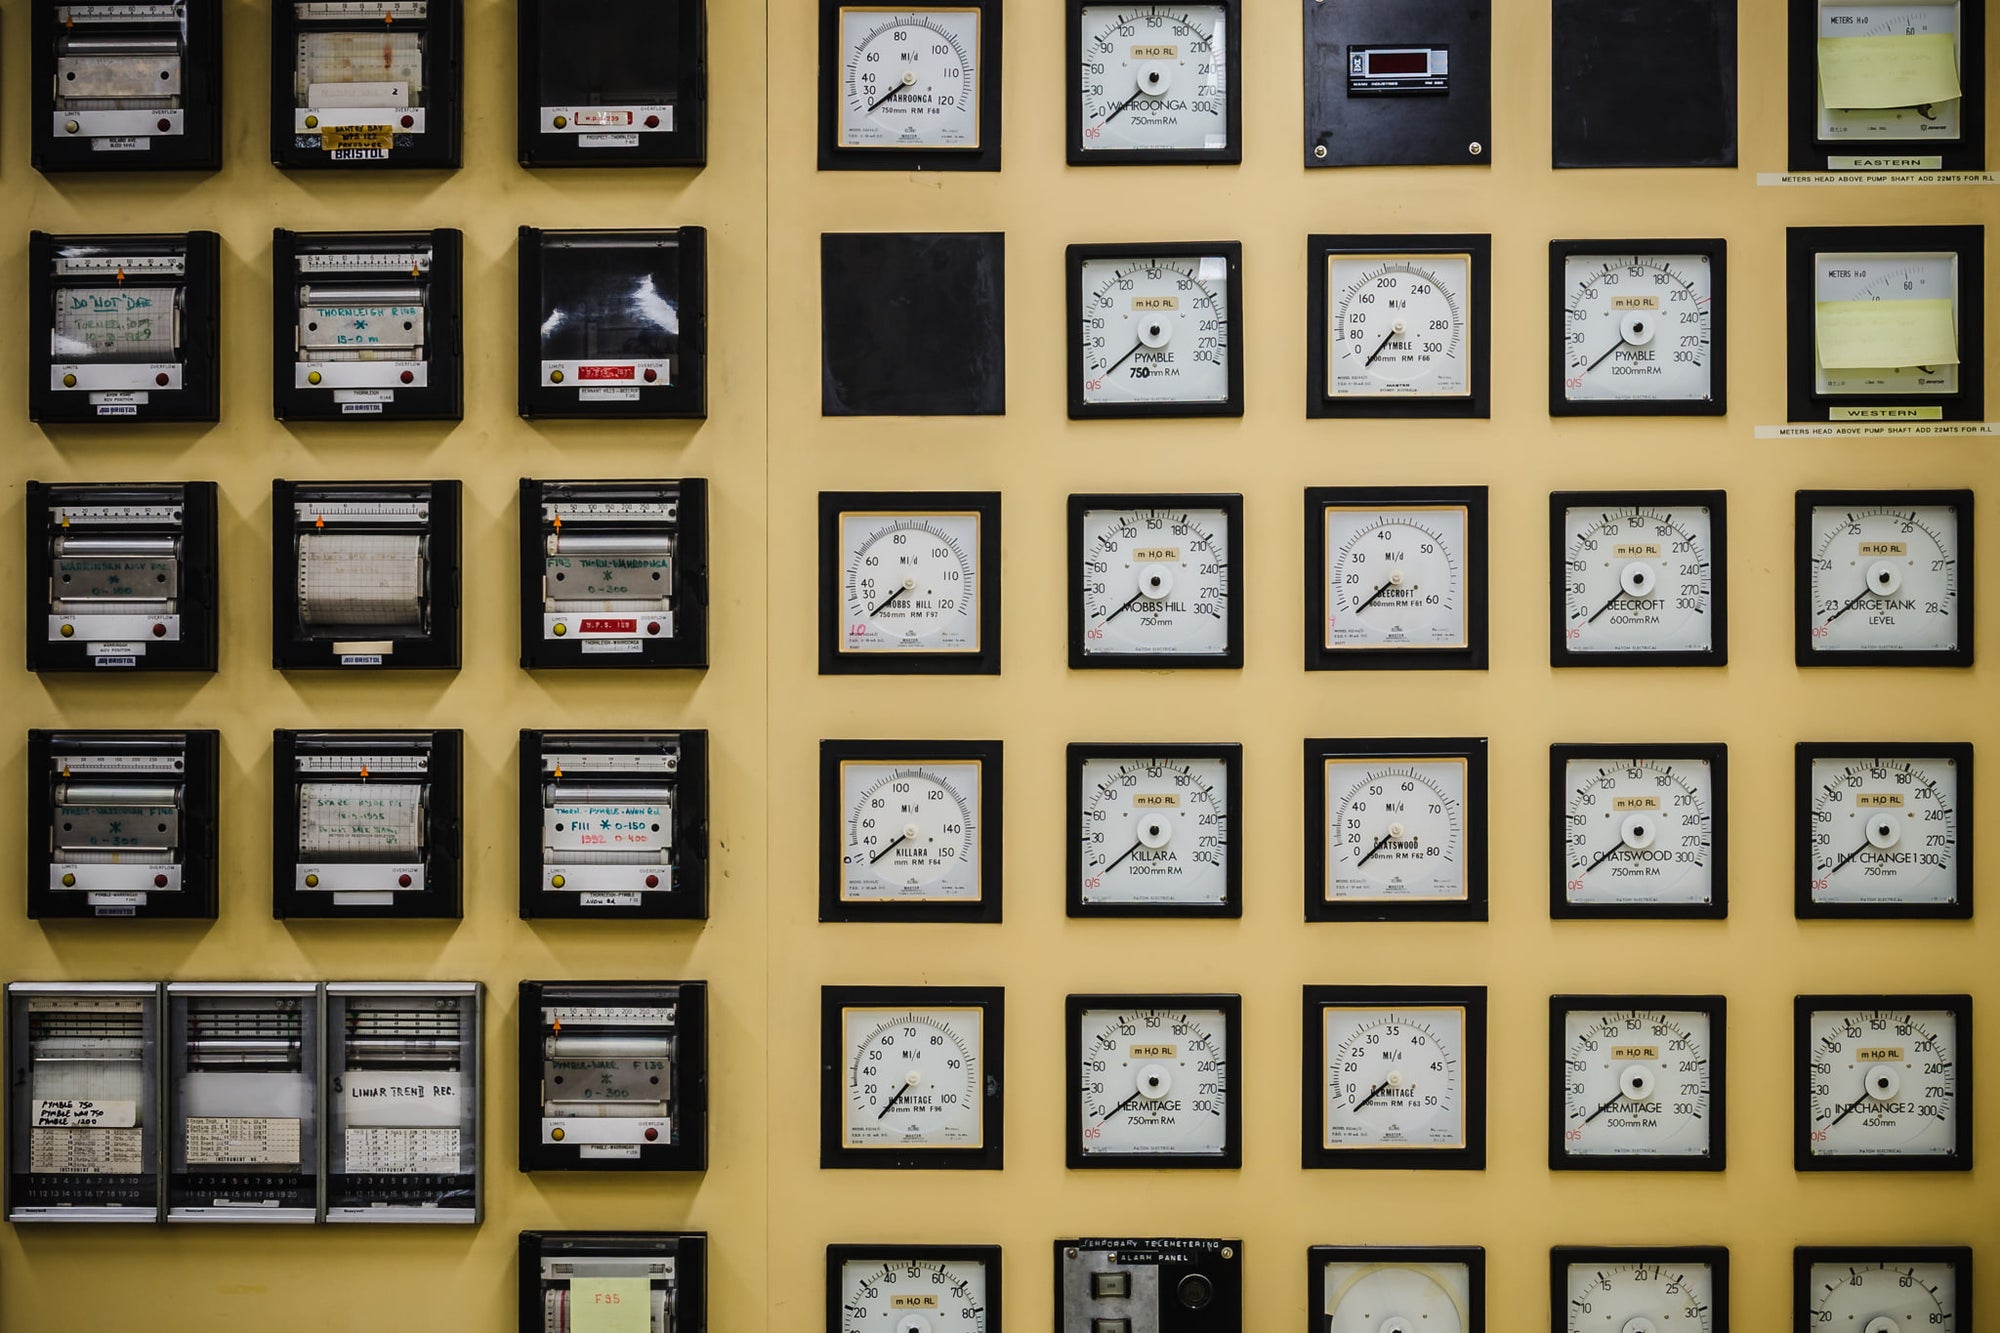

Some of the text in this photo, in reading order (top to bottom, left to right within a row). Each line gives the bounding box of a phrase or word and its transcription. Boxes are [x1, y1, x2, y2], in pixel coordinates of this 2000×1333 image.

[1831, 16, 1853, 24] METERS
[863, 85, 876, 95] 30
[1091, 85, 1103, 95] 30
[887, 95, 932, 103] WAHROONGA
[938, 96, 954, 105] 120
[1107, 100, 1187, 111] WAHROONGA
[1192, 101, 1210, 112] 300
[335, 149, 384, 159] BRISTOL
[1829, 270, 1851, 278] METERS
[1904, 281, 1912, 290] 60
[1350, 330, 1363, 339] 80
[1383, 342, 1412, 350] PYMBLE
[1680, 336, 1698, 346] 270
[1423, 343, 1442, 352] 300
[1135, 353, 1174, 362] PYMBLE
[1193, 351, 1212, 361] 300
[1616, 351, 1655, 361] PYMBLE
[1165, 368, 1180, 376] RM
[1848, 524, 1861, 535] 25
[1901, 522, 1913, 533] 26
[1931, 561, 1943, 571] 27
[1346, 574, 1359, 583] 20
[916, 600, 931, 609] HILL
[1426, 595, 1439, 604] 60
[1166, 602, 1186, 612] HILL
[1607, 600, 1665, 610] BEECROFT
[1844, 600, 1915, 610] SURGE TANK
[1925, 602, 1938, 613] 28
[1869, 617, 1895, 625] LEVEL
[1369, 786, 1382, 795] 50
[872, 799, 885, 808] 80
[1428, 804, 1441, 814] 70
[943, 825, 960, 834] 140
[896, 848, 927, 857] KILLARA
[939, 848, 954, 857] 150
[1131, 851, 1177, 861] KILLARA
[1427, 847, 1440, 856] 80
[1593, 851, 1672, 861] CHATSWOOD
[1860, 853, 1914, 863] CHANGE
[1168, 866, 1182, 874] RM
[1645, 868, 1660, 876] RM
[1386, 1026, 1399, 1036] 35
[869, 1051, 882, 1060] 50
[947, 1060, 960, 1069] 90
[1430, 1062, 1442, 1071] 45
[941, 1094, 956, 1104] 100
[1118, 1101, 1181, 1111] HERMITAGE
[1598, 1103, 1662, 1113] HERMITAGE
[1161, 1116, 1175, 1124] RM
[1643, 1119, 1657, 1127] RM
[908, 1267, 920, 1278] 50
[1635, 1270, 1647, 1281] 20
[1899, 1277, 1912, 1287] 60
[865, 1288, 878, 1298] 30
[1666, 1283, 1679, 1294] 25
[854, 1307, 866, 1318] 20
[962, 1308, 975, 1319] 80
[1581, 1303, 1591, 1314] 10
[1685, 1307, 1698, 1318] 30
[1819, 1311, 1832, 1321] 20
[1929, 1313, 1943, 1324] 80
